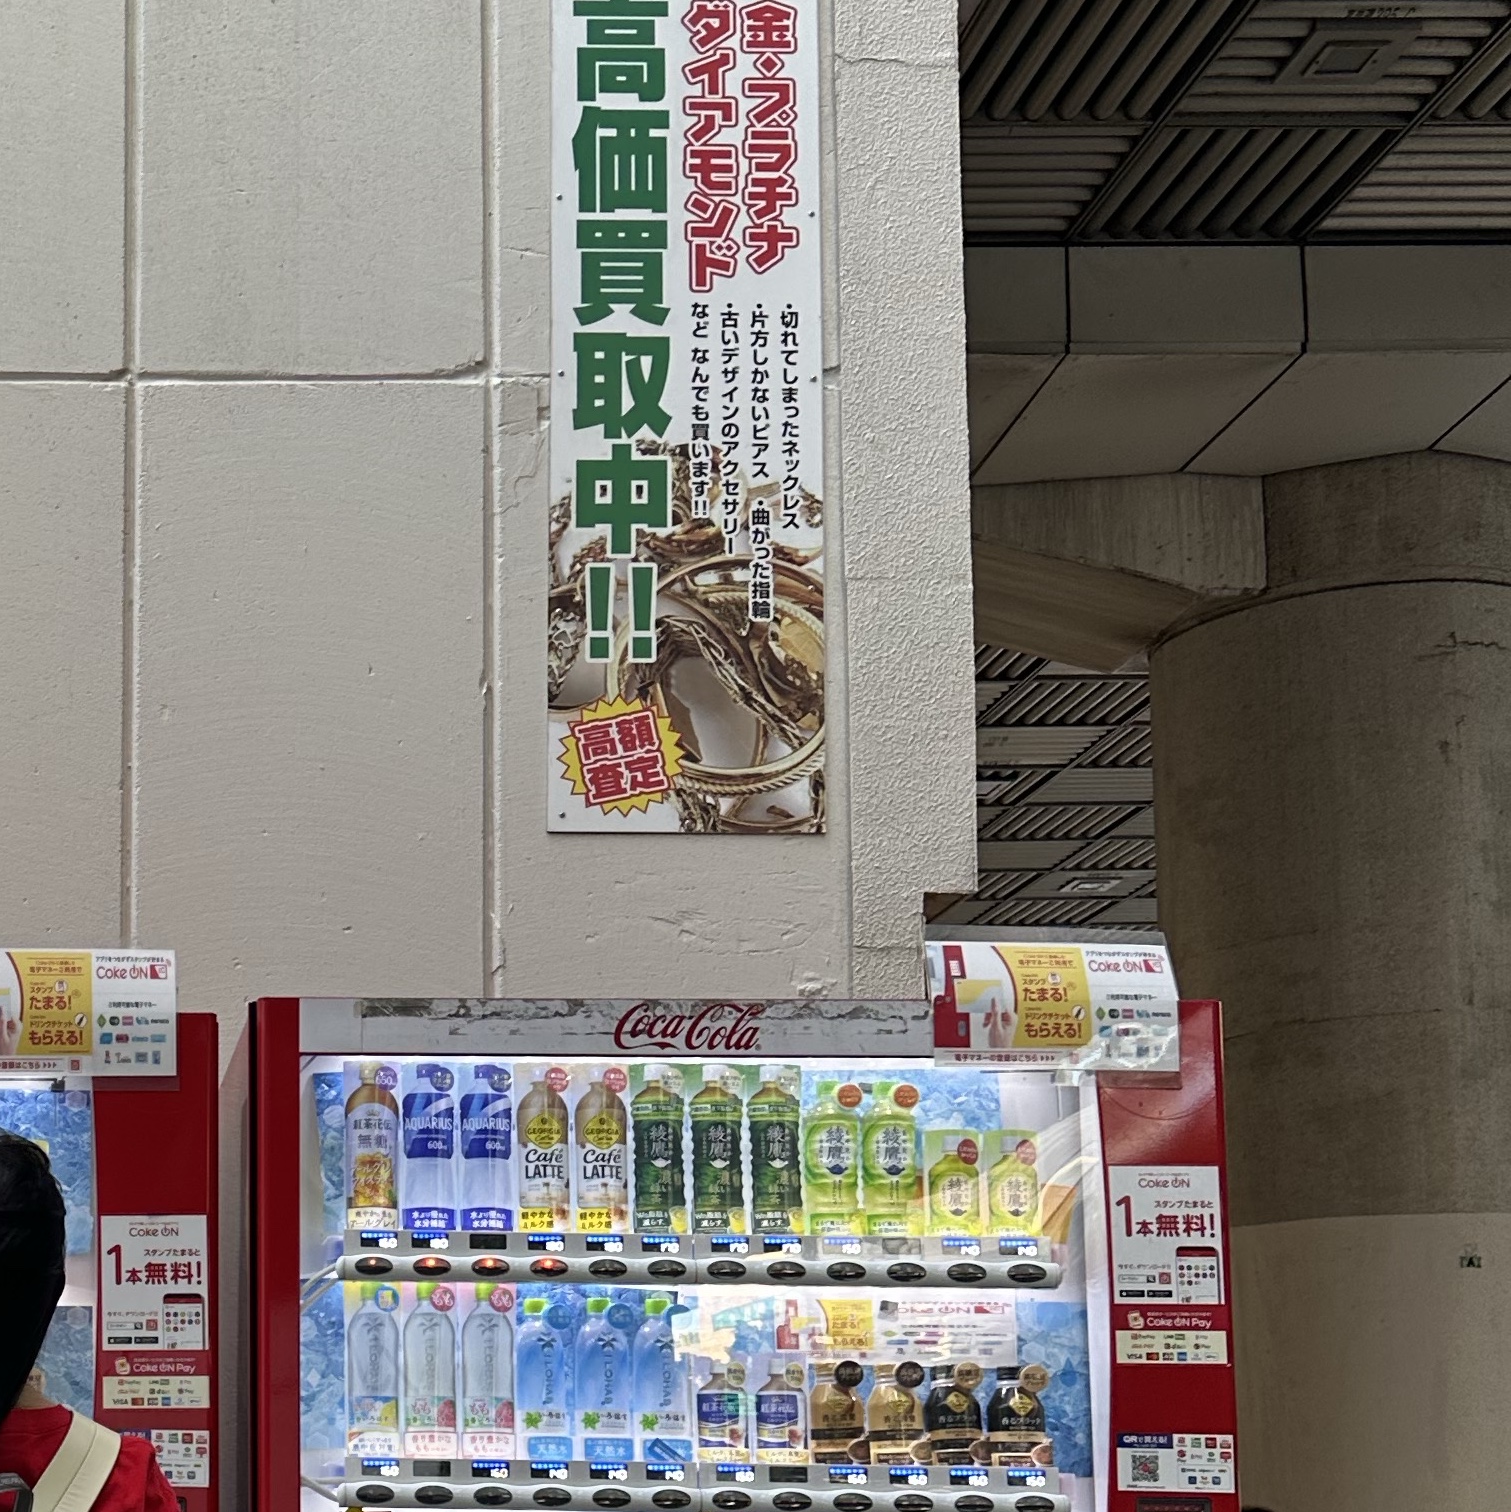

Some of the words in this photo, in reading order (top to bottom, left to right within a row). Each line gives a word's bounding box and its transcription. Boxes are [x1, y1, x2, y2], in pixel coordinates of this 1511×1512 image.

[681, 0, 740, 292] ダイアモンド
[691, 302, 710, 338] など
[575, 711, 659, 764] 高額
[582, 751, 670, 807] 査定
[96, 966, 127, 980] Coke
[129, 965, 149, 980] ON
[1088, 960, 1121, 973] Coke
[1123, 960, 1144, 973] ON
[1022, 978, 1046, 986] スタンプ
[30, 986, 53, 994] スタンプ
[1023, 987, 1069, 1002] たまる!
[29, 996, 72, 1011] たまる!
[29, 1020, 74, 1028] ドリンクチケット
[1024, 1022, 1082, 1039] もらえる!
[29, 1031, 84, 1046] もらえる!
[404, 1117, 453, 1131] AQUARIUS
[462, 1117, 510, 1131] AQUARIUS
[825, 1126, 845, 1162] 綾鷹
[882, 1127, 902, 1163] 綾鷹
[525, 1148, 563, 1164] Café
[583, 1149, 622, 1164] Café
[525, 1164, 564, 1180] LATTE
[583, 1165, 623, 1180] LATTE
[1154, 1200, 1214, 1209] スタンプたまると
[521, 1211, 553, 1219] 軽やかな
[1115, 1194, 1216, 1239] 1本無料!
[143, 1248, 201, 1257] スタンプたまると
[106, 1244, 203, 1286] 1本無料!
[1146, 1317, 1173, 1327] Coke
[1191, 1317, 1212, 1330] Pay
[132, 1363, 159, 1373] Coke
[176, 1363, 196, 1374] Pay
[595, 1445, 626, 1457] 天然水
